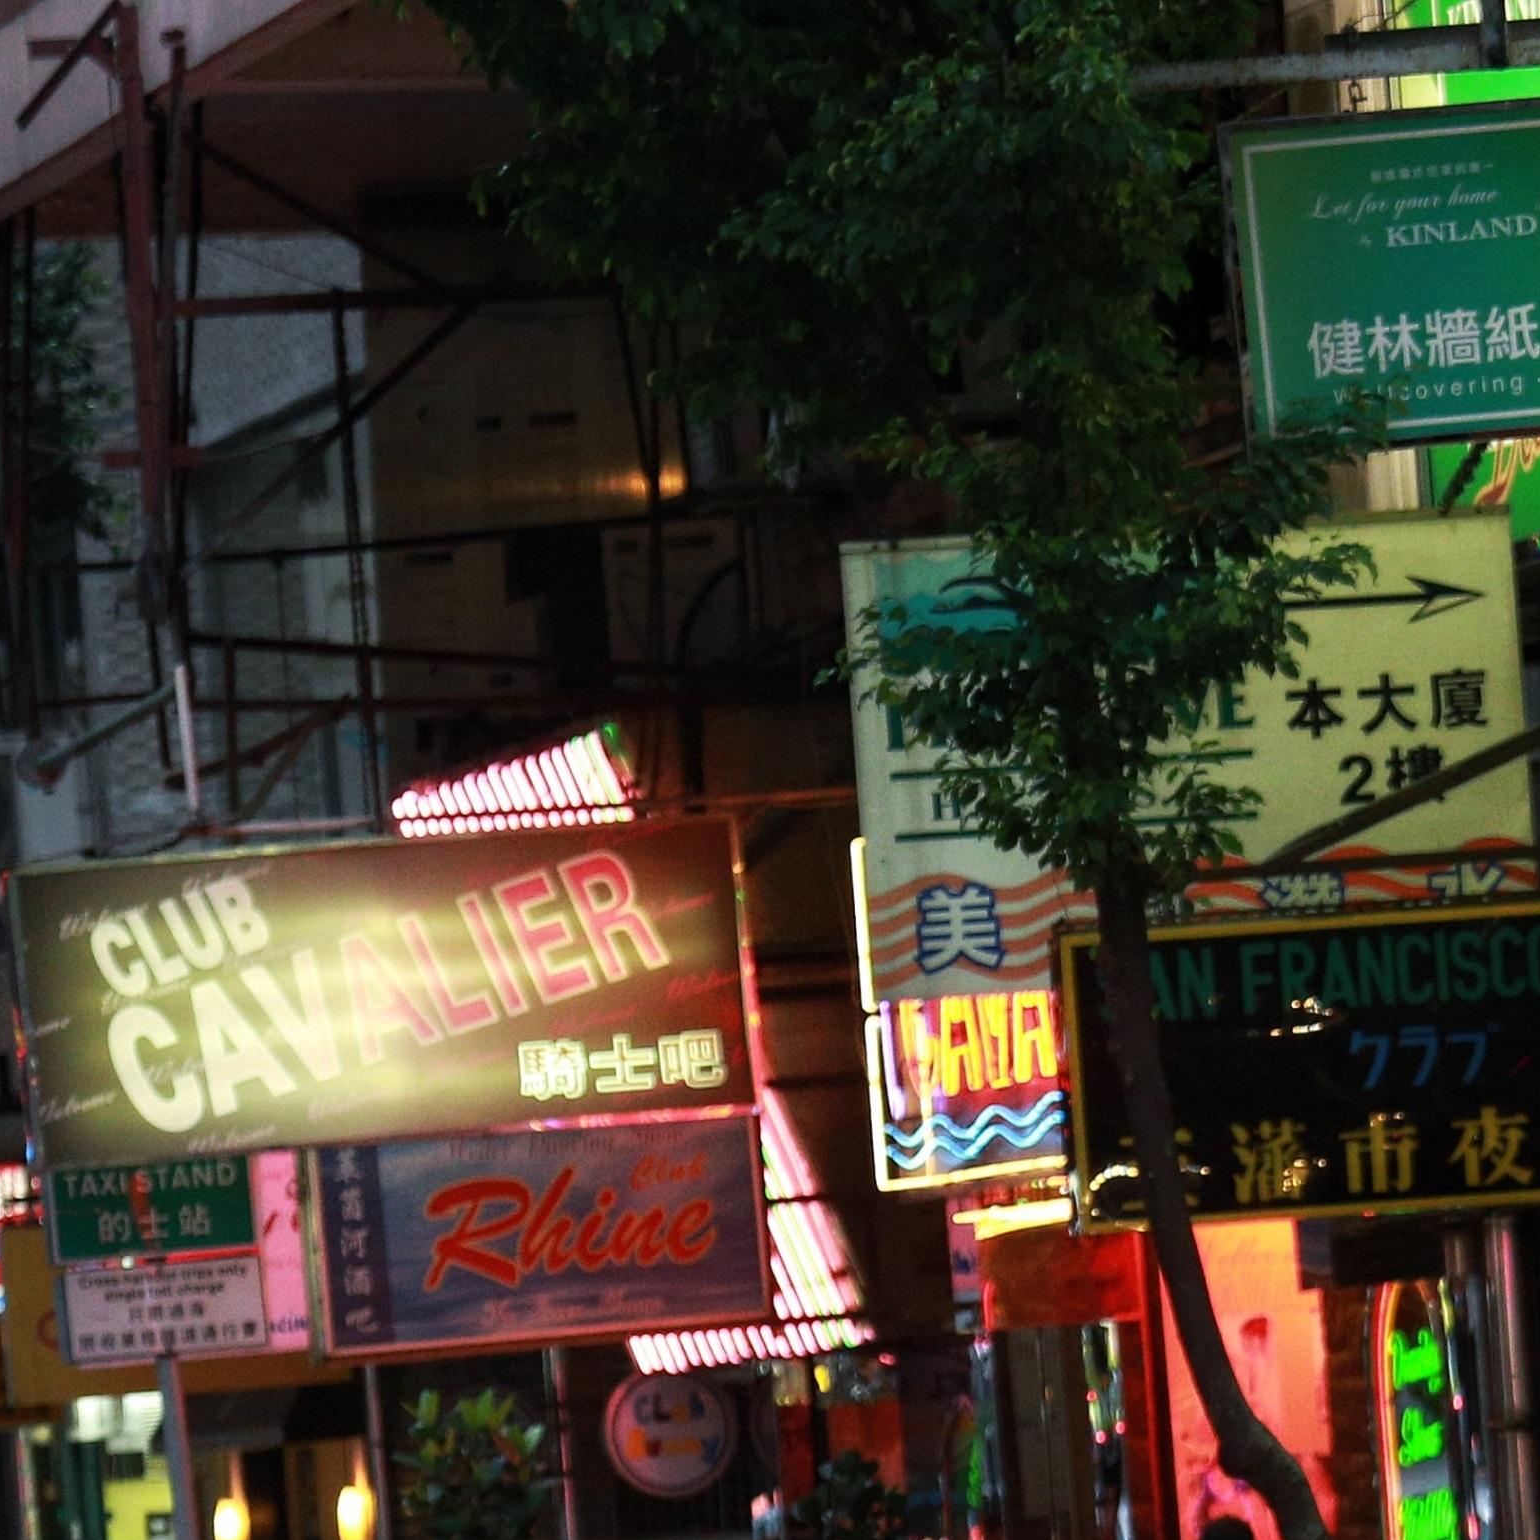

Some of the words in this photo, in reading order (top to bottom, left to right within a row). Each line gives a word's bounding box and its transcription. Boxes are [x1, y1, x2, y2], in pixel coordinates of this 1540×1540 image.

[1385, 214, 1539, 248] KINLAND
[1393, 197, 1440, 220] your
[1446, 184, 1498, 207] home
[1286, 667, 1488, 740] 本大廈
[89, 874, 272, 1000] CLUB
[107, 851, 672, 1134] CAVALIER
[516, 1028, 728, 1101] 騎士吧
[66, 1173, 130, 1199] TAXI
[135, 1161, 238, 1195] STAND
[97, 1203, 211, 1244] 的士站
[423, 1165, 716, 1293] Rhine
